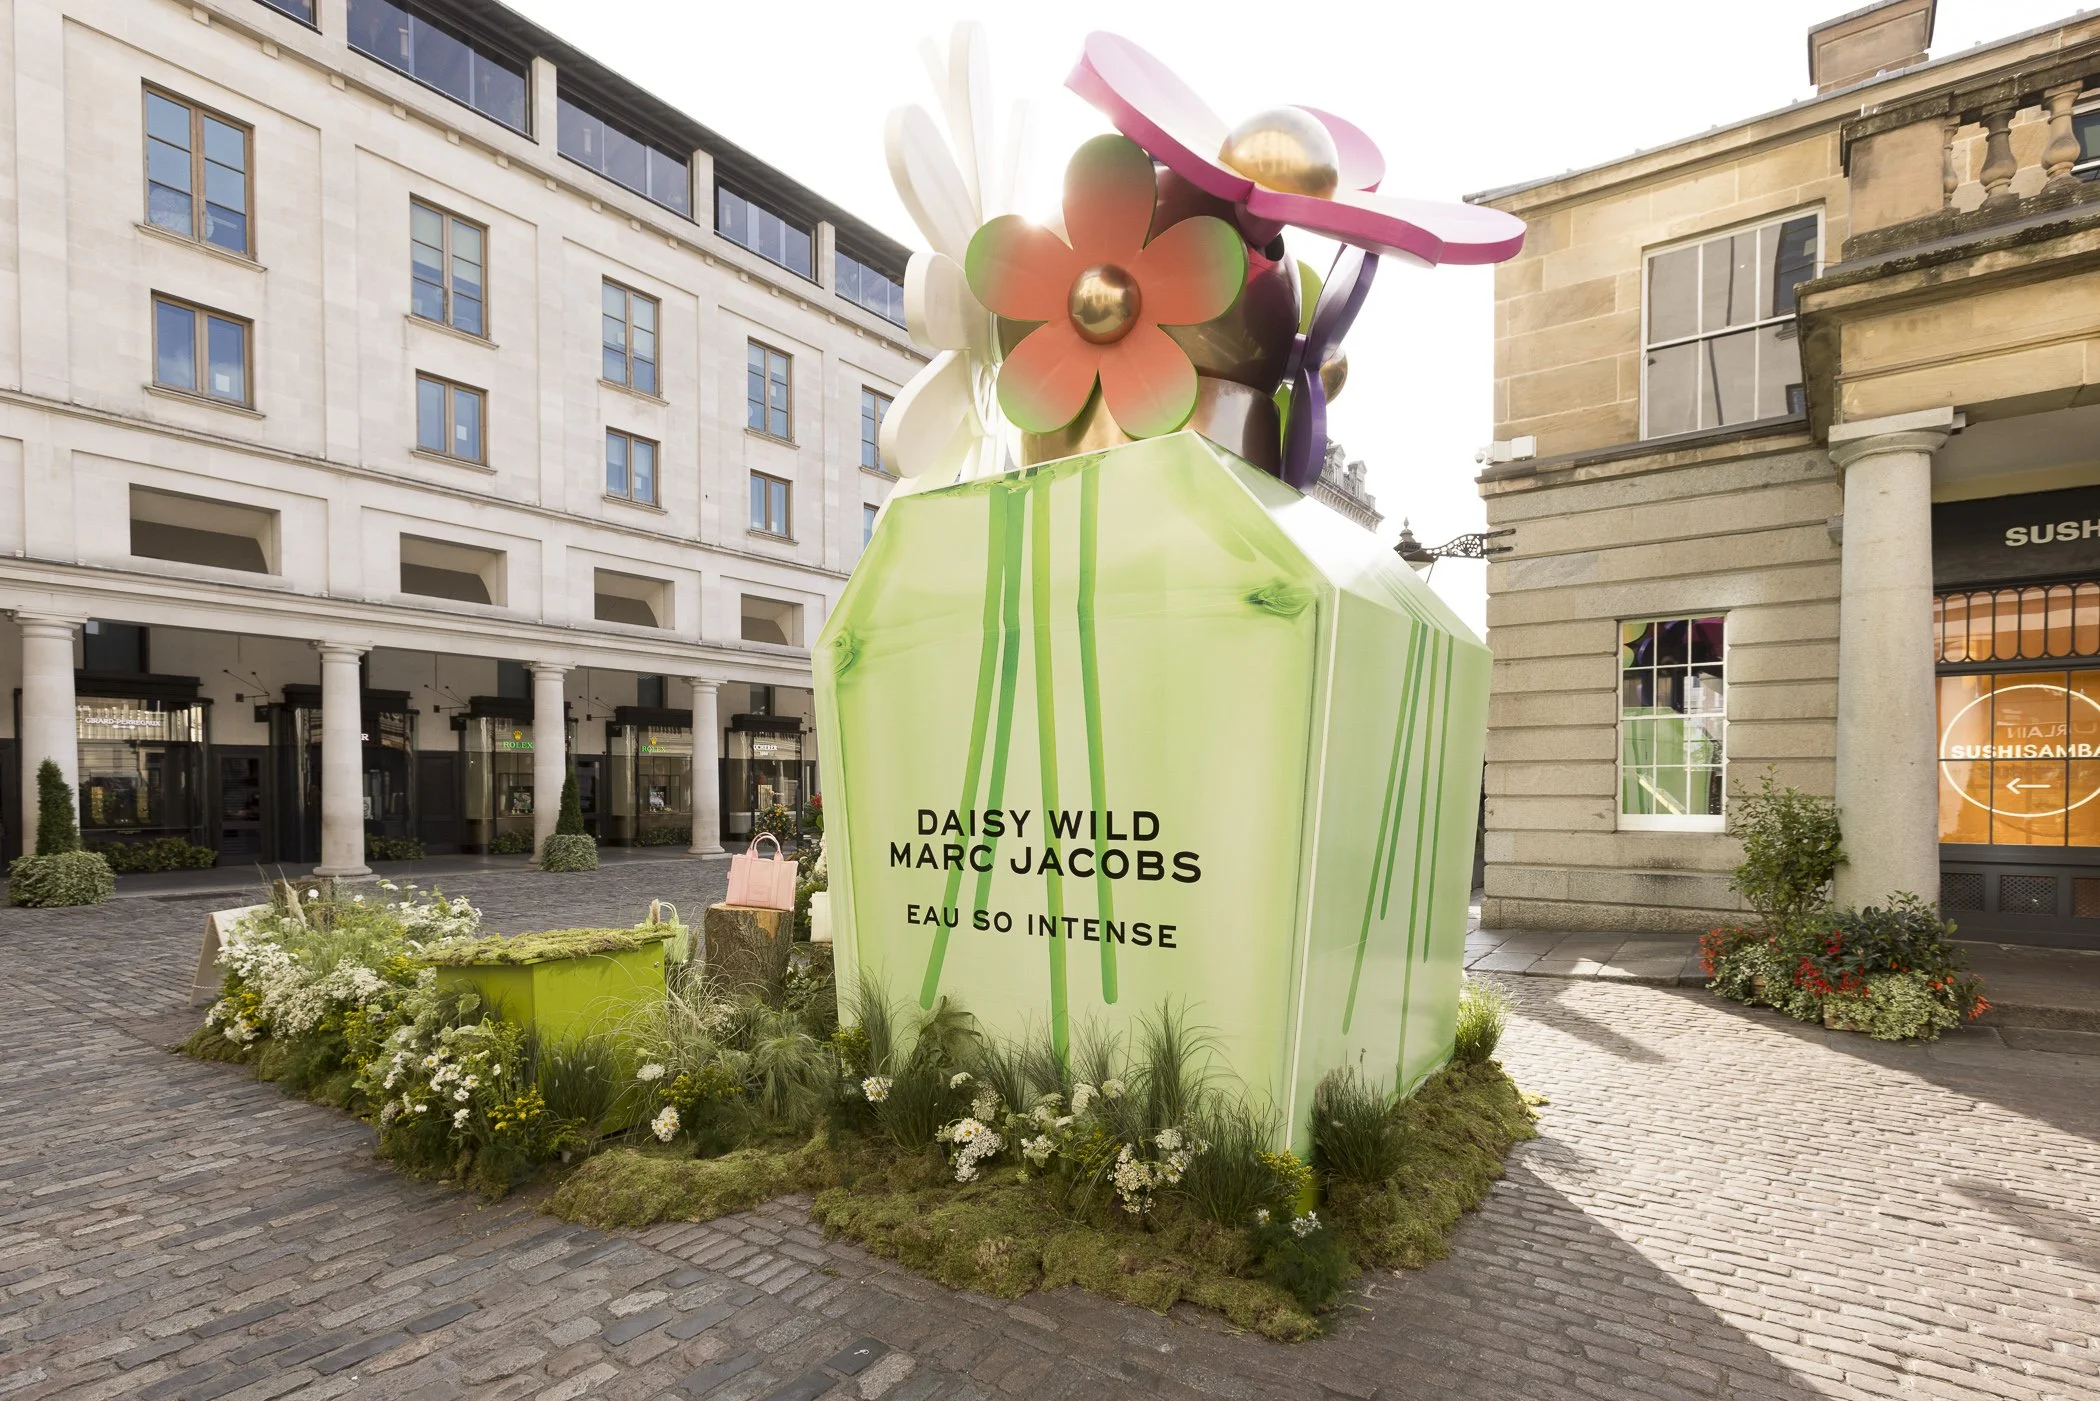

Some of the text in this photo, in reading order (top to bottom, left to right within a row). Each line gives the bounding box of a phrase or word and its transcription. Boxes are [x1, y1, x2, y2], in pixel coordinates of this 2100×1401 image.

[85, 717, 161, 727] GIRARD-PERREGAUX
[503, 741, 533, 749] ROLEX
[641, 745, 666, 753] ROLEX
[917, 809, 1160, 842] DAISY WILD
[890, 841, 1202, 884] MARC JACOBS
[907, 904, 1177, 949] EAU SO INTENSE
